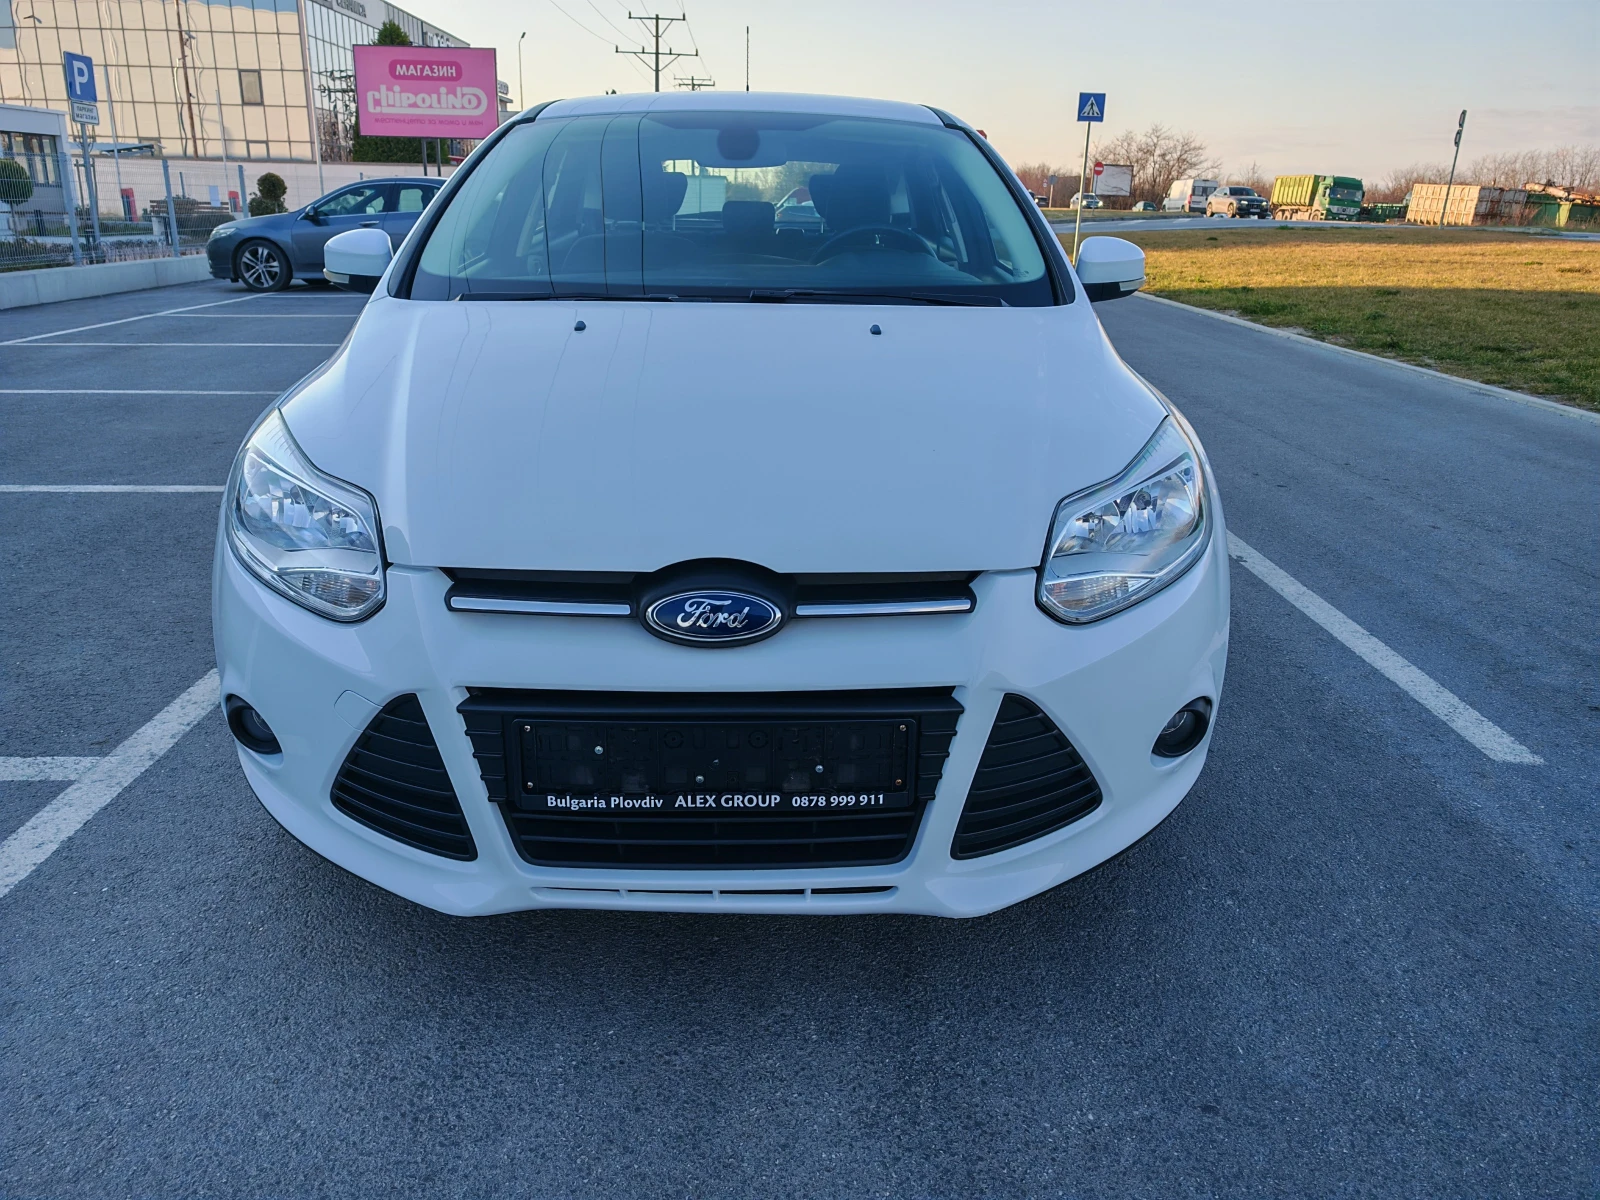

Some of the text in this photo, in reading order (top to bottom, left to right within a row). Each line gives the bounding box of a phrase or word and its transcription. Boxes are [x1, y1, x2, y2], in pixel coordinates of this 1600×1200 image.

[72, 60, 89, 95] P
[396, 64, 456, 77] МАГАЗИН
[676, 598, 750, 628] Ford
[547, 793, 884, 811] Bulgaria Plovdiv ALEX GROUP 0878 999 911
